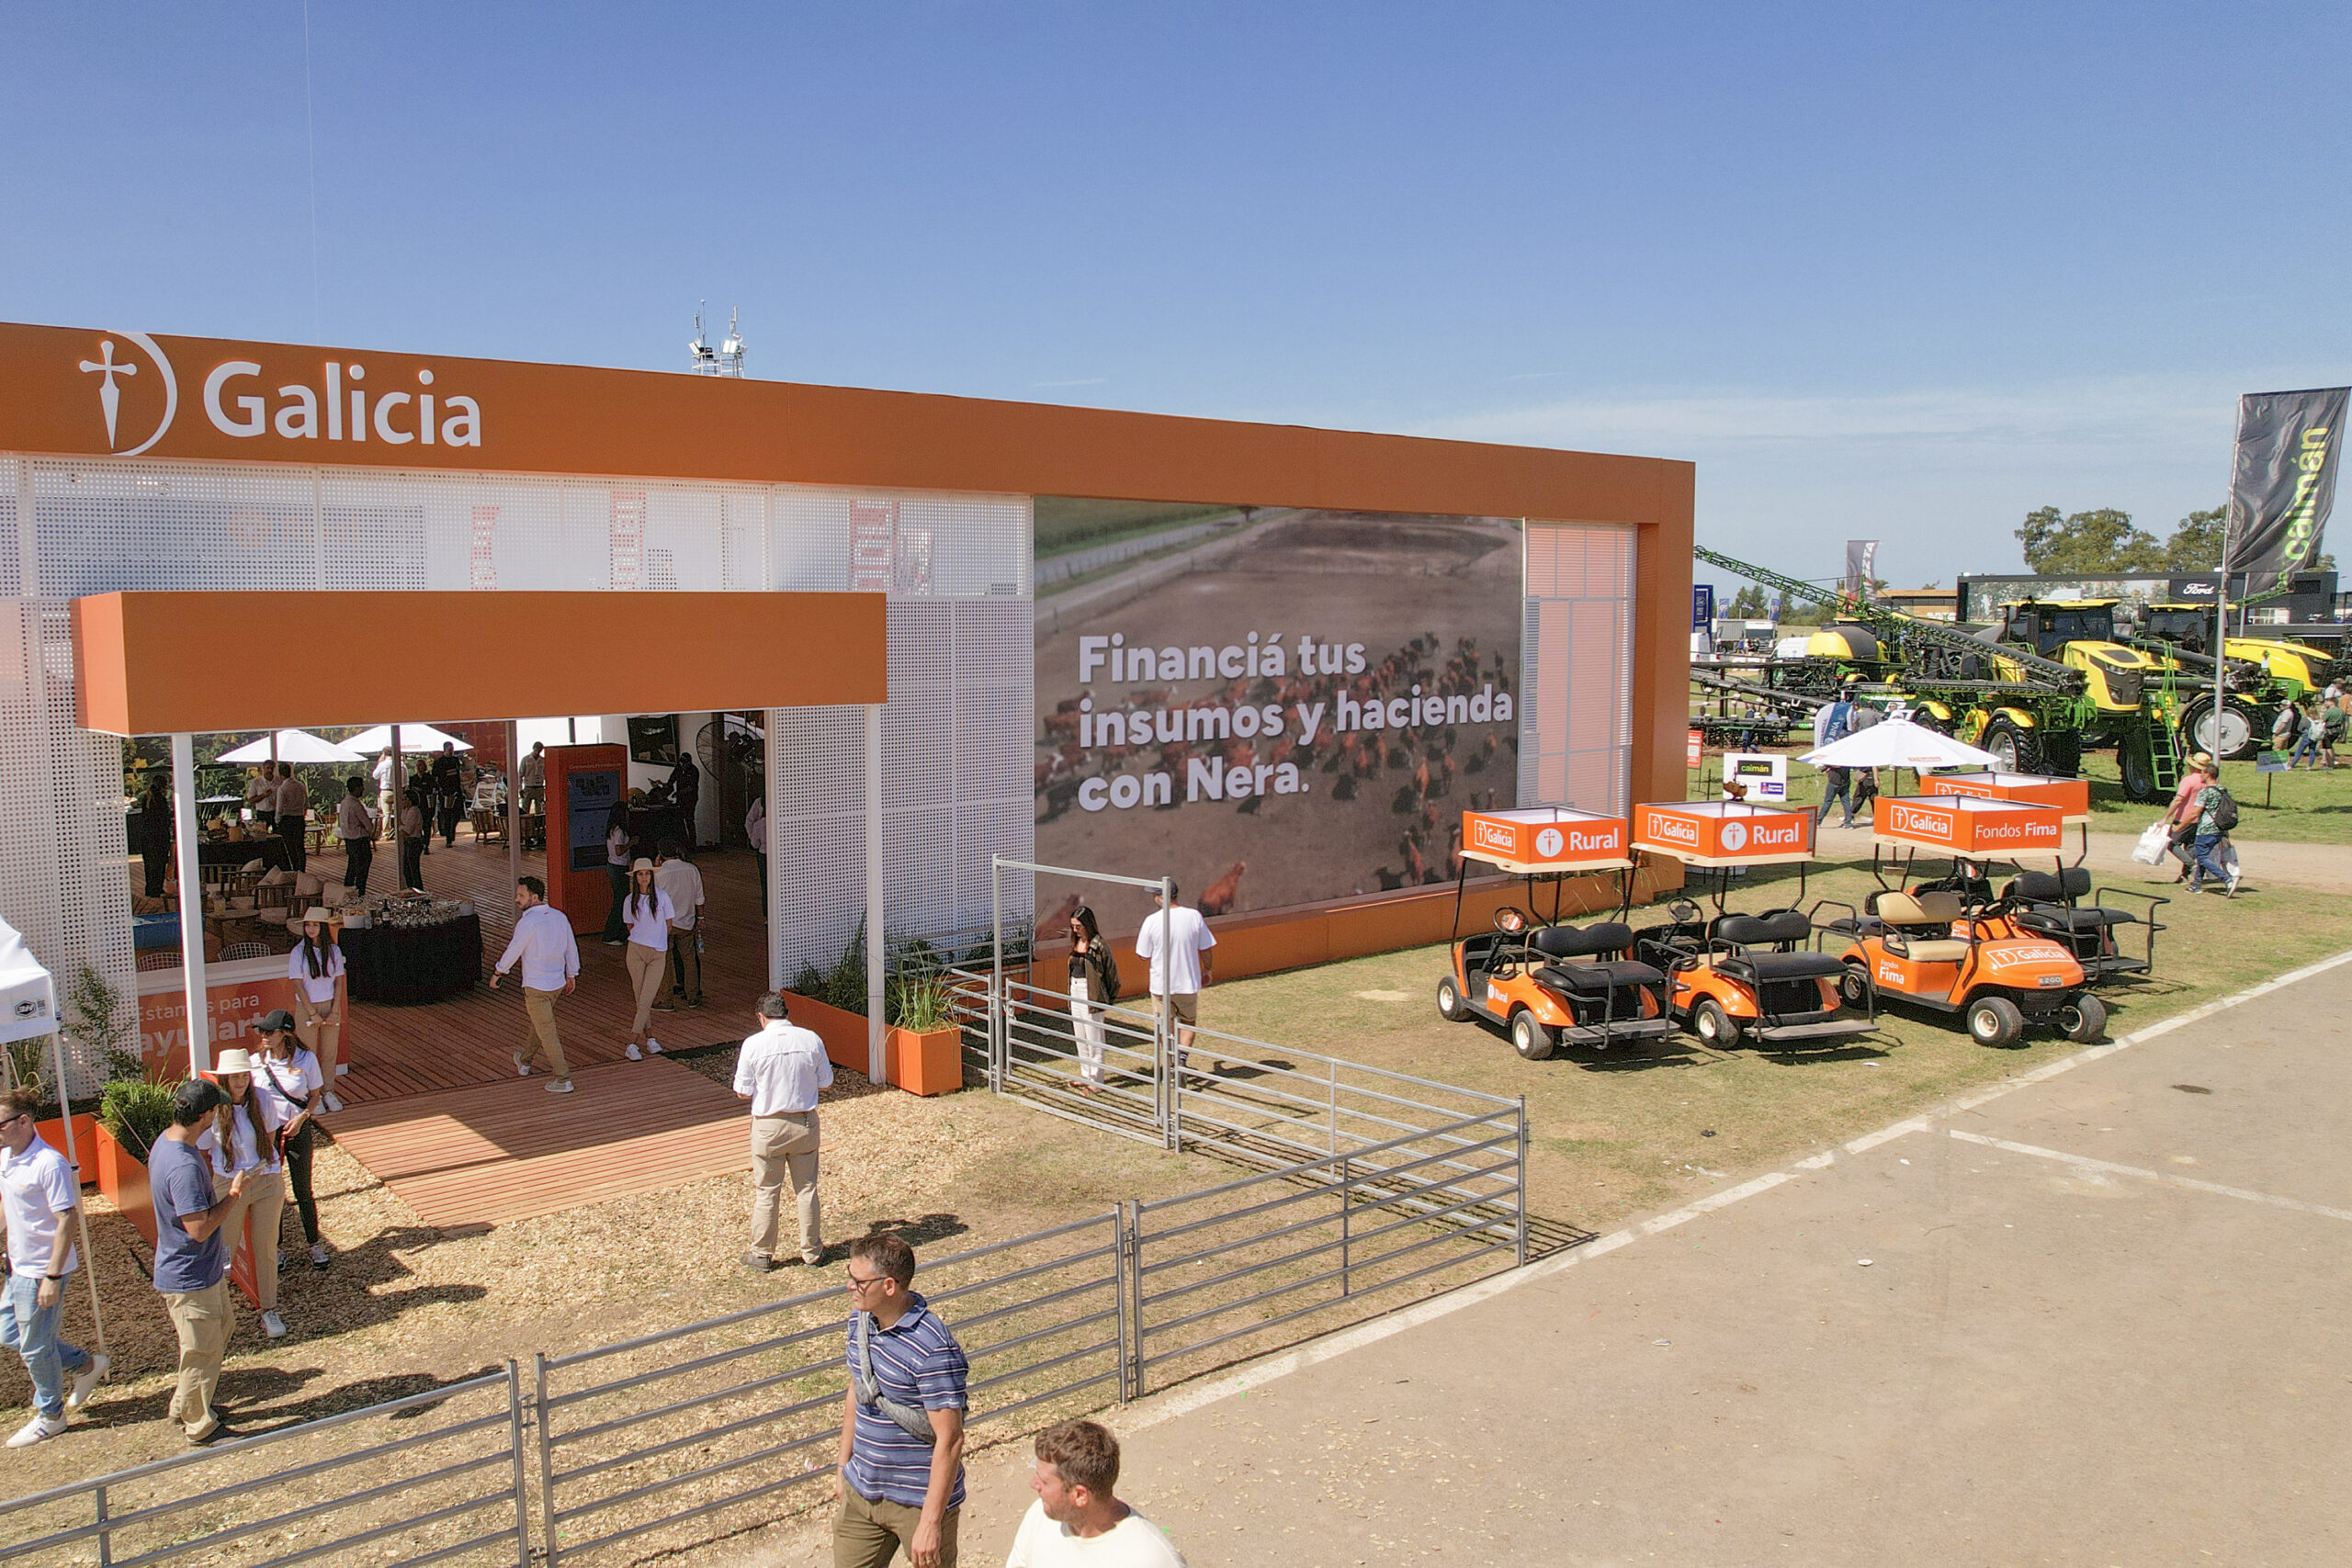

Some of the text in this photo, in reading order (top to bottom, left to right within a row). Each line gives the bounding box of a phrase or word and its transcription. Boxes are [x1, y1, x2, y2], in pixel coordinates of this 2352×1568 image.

[203, 361, 481, 447] Galicia
[2284, 427, 2328, 560] caimán
[2183, 583, 2214, 595] Ford
[1080, 631, 1366, 682] Financiá tus
[1080, 683, 1513, 748] insumos y hacienda
[1741, 764, 1770, 773] caimán
[1078, 756, 1309, 812] con Nera.
[1664, 821, 1695, 840] Galicia
[1753, 822, 1799, 844] Rural
[1910, 814, 1948, 834] Galicia
[1975, 822, 2057, 839] Fondos Fima
[1487, 829, 1512, 847] Galicia
[1570, 828, 1619, 851] Rural
[2017, 947, 2066, 960] Galicia
[1879, 966, 1905, 985] Fima
[220, 995, 259, 1014] para
